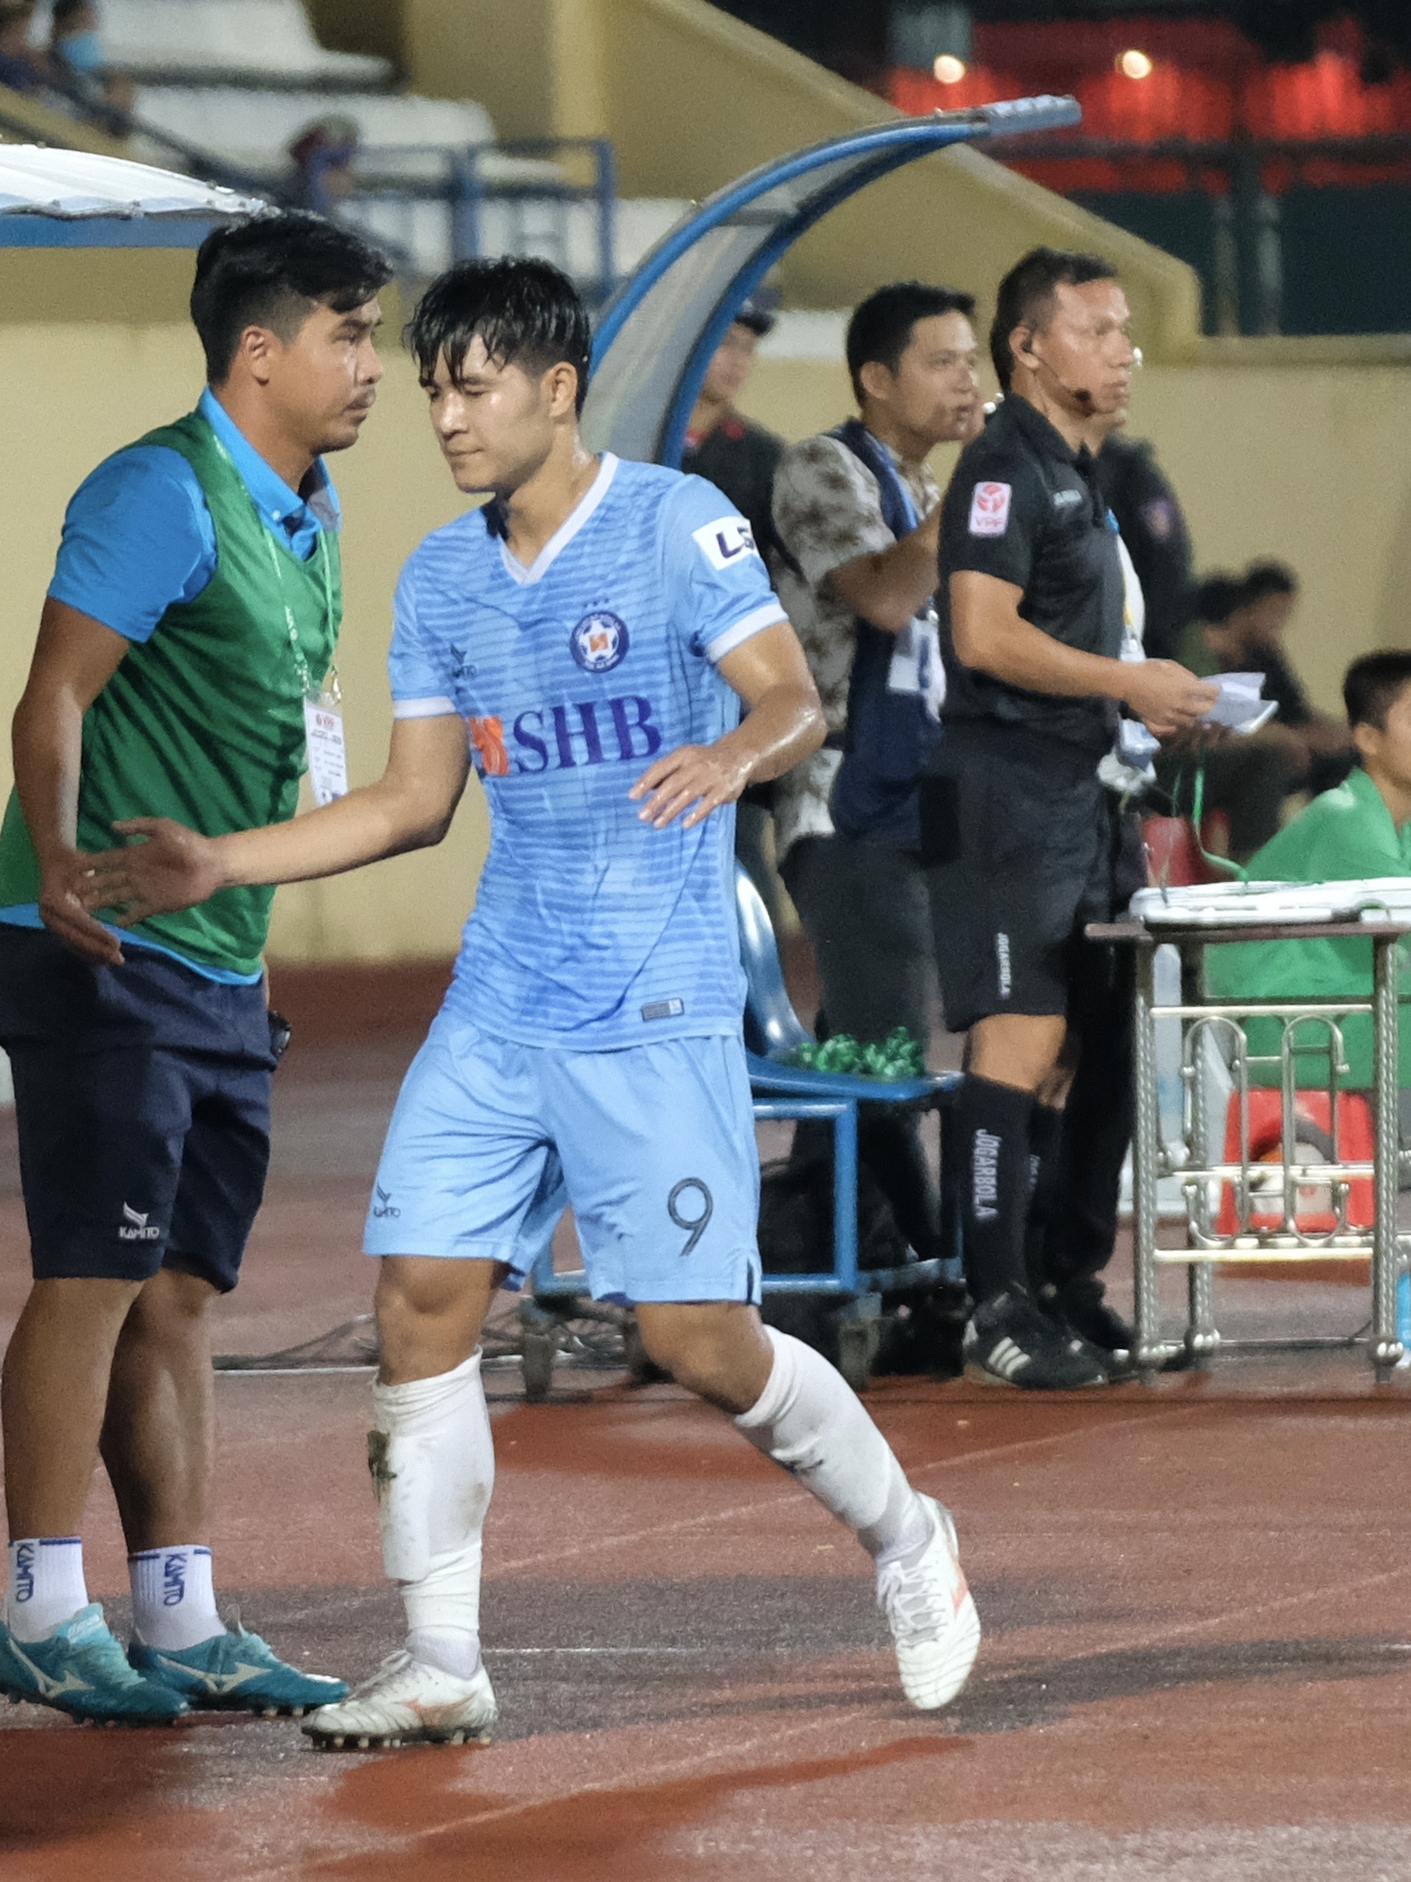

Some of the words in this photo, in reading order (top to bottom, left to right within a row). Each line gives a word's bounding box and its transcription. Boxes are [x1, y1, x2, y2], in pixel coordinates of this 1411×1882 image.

[513, 695, 663, 773] SHB
[974, 1129, 1003, 1219] JOGARBOLA
[119, 1226, 160, 1240] KAMITO
[667, 1176, 713, 1257] 9
[15, 1542, 35, 1603] KAMITO
[163, 1553, 188, 1607] KAMITO
